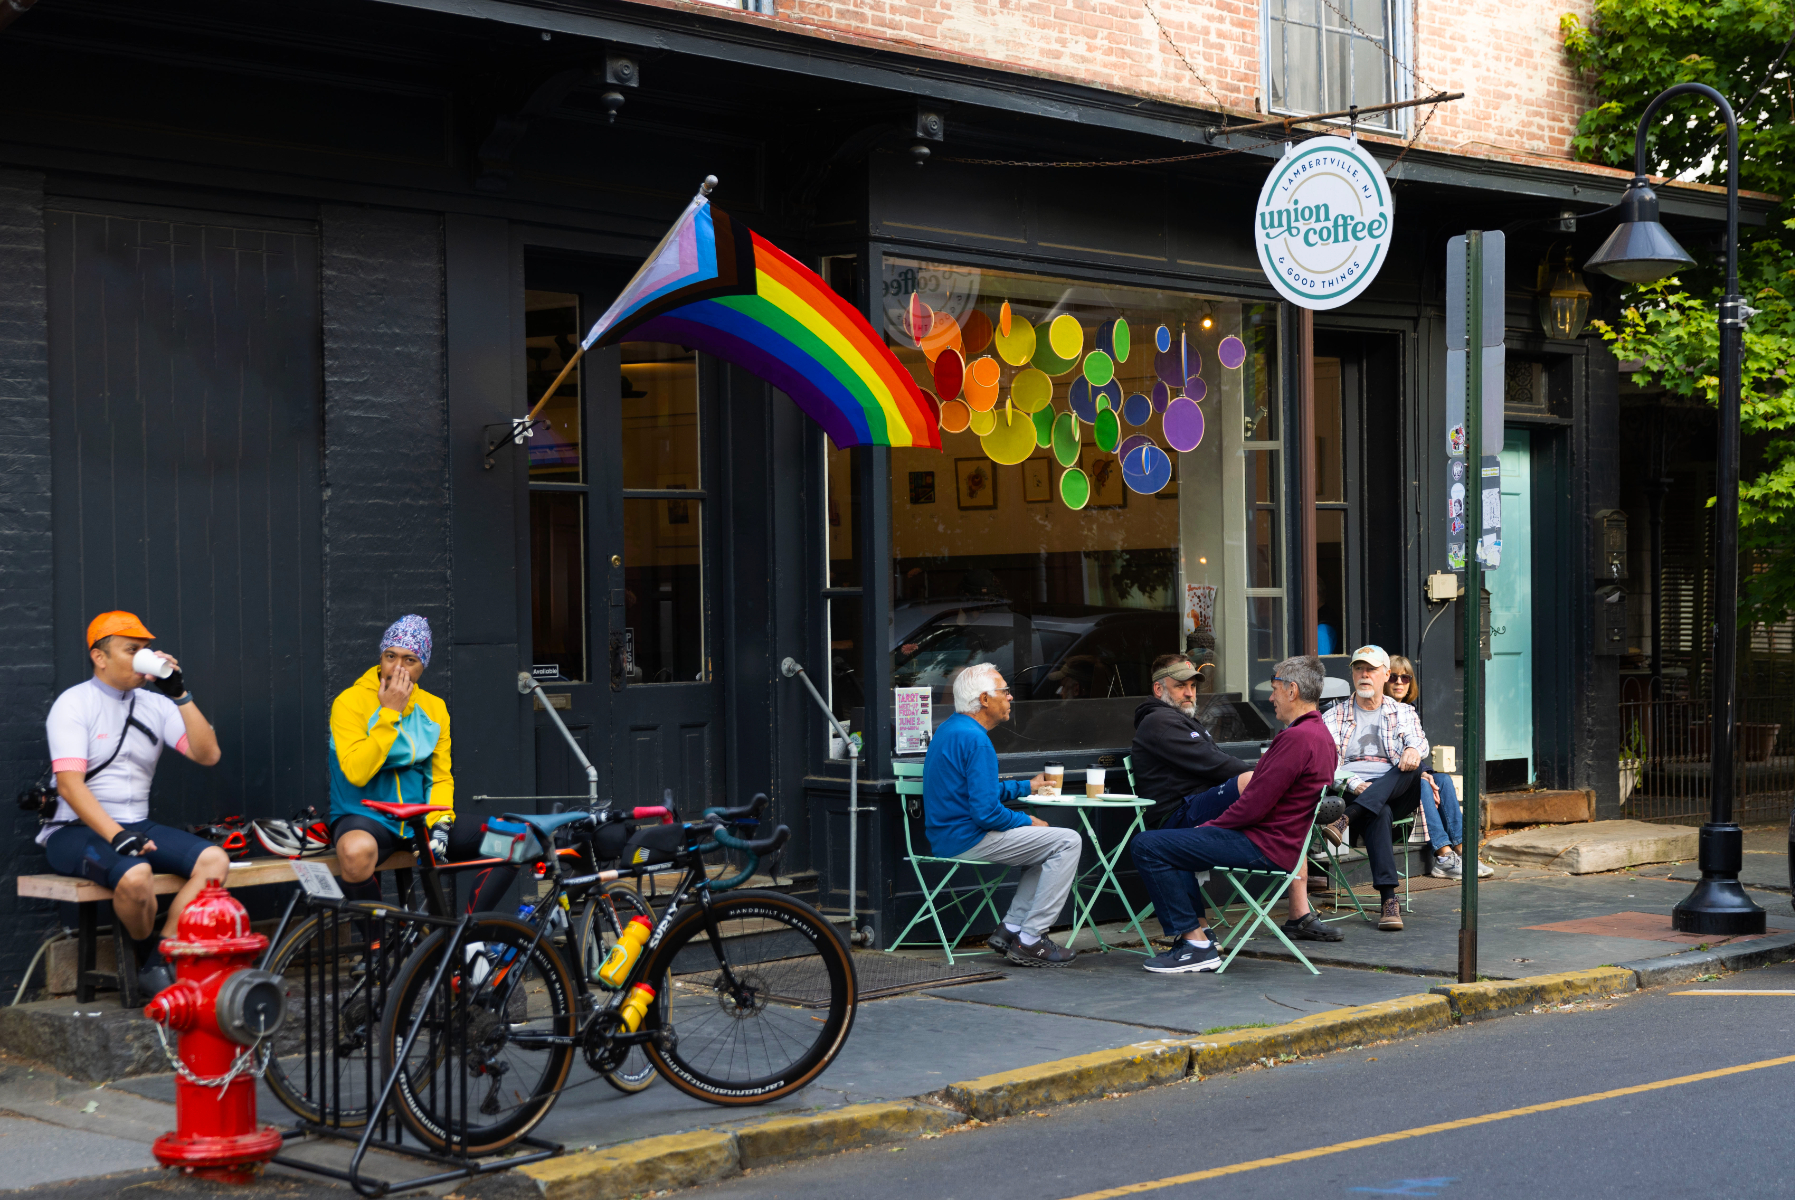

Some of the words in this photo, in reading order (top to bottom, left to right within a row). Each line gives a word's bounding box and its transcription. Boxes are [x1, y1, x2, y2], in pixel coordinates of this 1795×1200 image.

[1282, 157, 1360, 192] LAMBERTVILLE,
[1361, 184, 1372, 199] NJ
[1259, 199, 1331, 239] union
[1303, 212, 1388, 247] coffee
[1287, 267, 1316, 288] GOOD
[1321, 261, 1360, 289] THINGS
[533, 667, 558, 675] Available
[899, 709, 919, 717] FRIDAY
[649, 902, 678, 949] SURLY
[729, 907, 778, 916] HANDBUILT
[791, 918, 818, 940] MANILA
